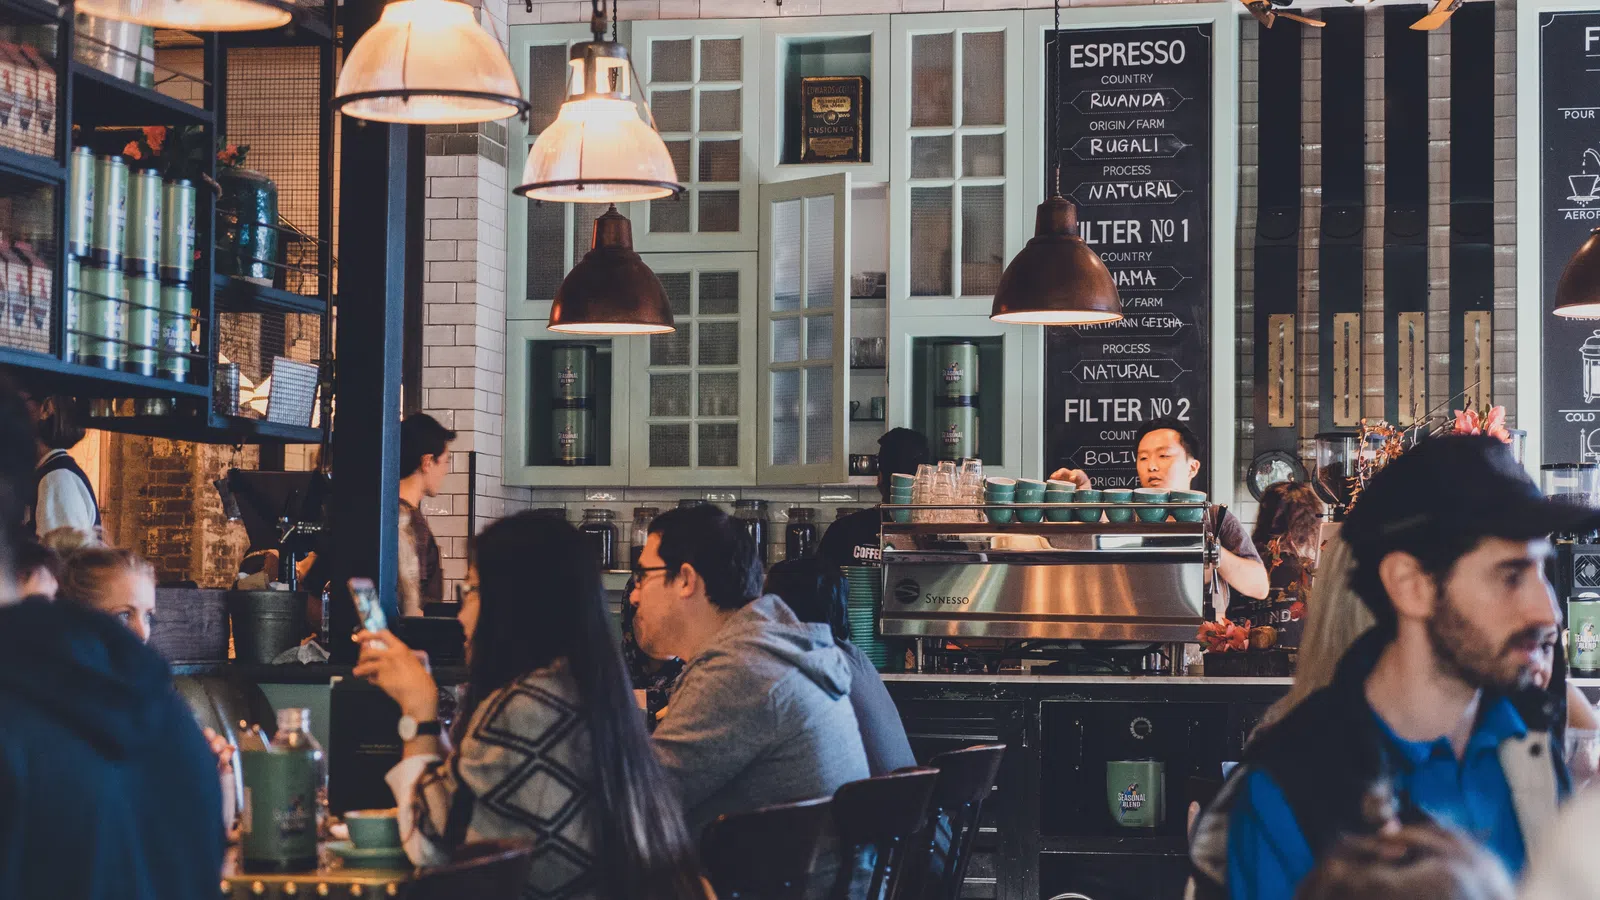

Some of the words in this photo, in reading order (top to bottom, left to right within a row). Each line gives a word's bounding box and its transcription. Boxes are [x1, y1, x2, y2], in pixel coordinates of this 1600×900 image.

[1070, 40, 1186, 68] ESPRESSO
[1101, 74, 1153, 84] COUNTRY
[1090, 92, 1165, 109] RWANDA
[1564, 110, 1595, 119] POUR
[808, 126, 838, 134] ENSIGN
[1089, 119, 1165, 130] ORIGIN/FARM
[1090, 137, 1158, 155] RUGALI
[1103, 165, 1151, 176] PROCESS
[1089, 182, 1177, 199] NATURAL
[1077, 220, 1142, 244] ILTER
[1181, 219, 1189, 243] 1
[1100, 252, 1152, 262] COUNTRY
[1113, 270, 1157, 286] NAMA
[1141, 317, 1183, 328] GEISHA
[1102, 344, 1151, 354] PROCESS
[1083, 364, 1160, 380] NATURAL
[1065, 399, 1142, 423] FILTER
[1177, 398, 1190, 421] 2
[1565, 413, 1595, 422] COLD
[1100, 430, 1137, 440] COUNT
[1084, 450, 1136, 466] BOLIV
[1090, 476, 1140, 487] ORIGIN/F
[1117, 792, 1146, 801] SEASONAL
